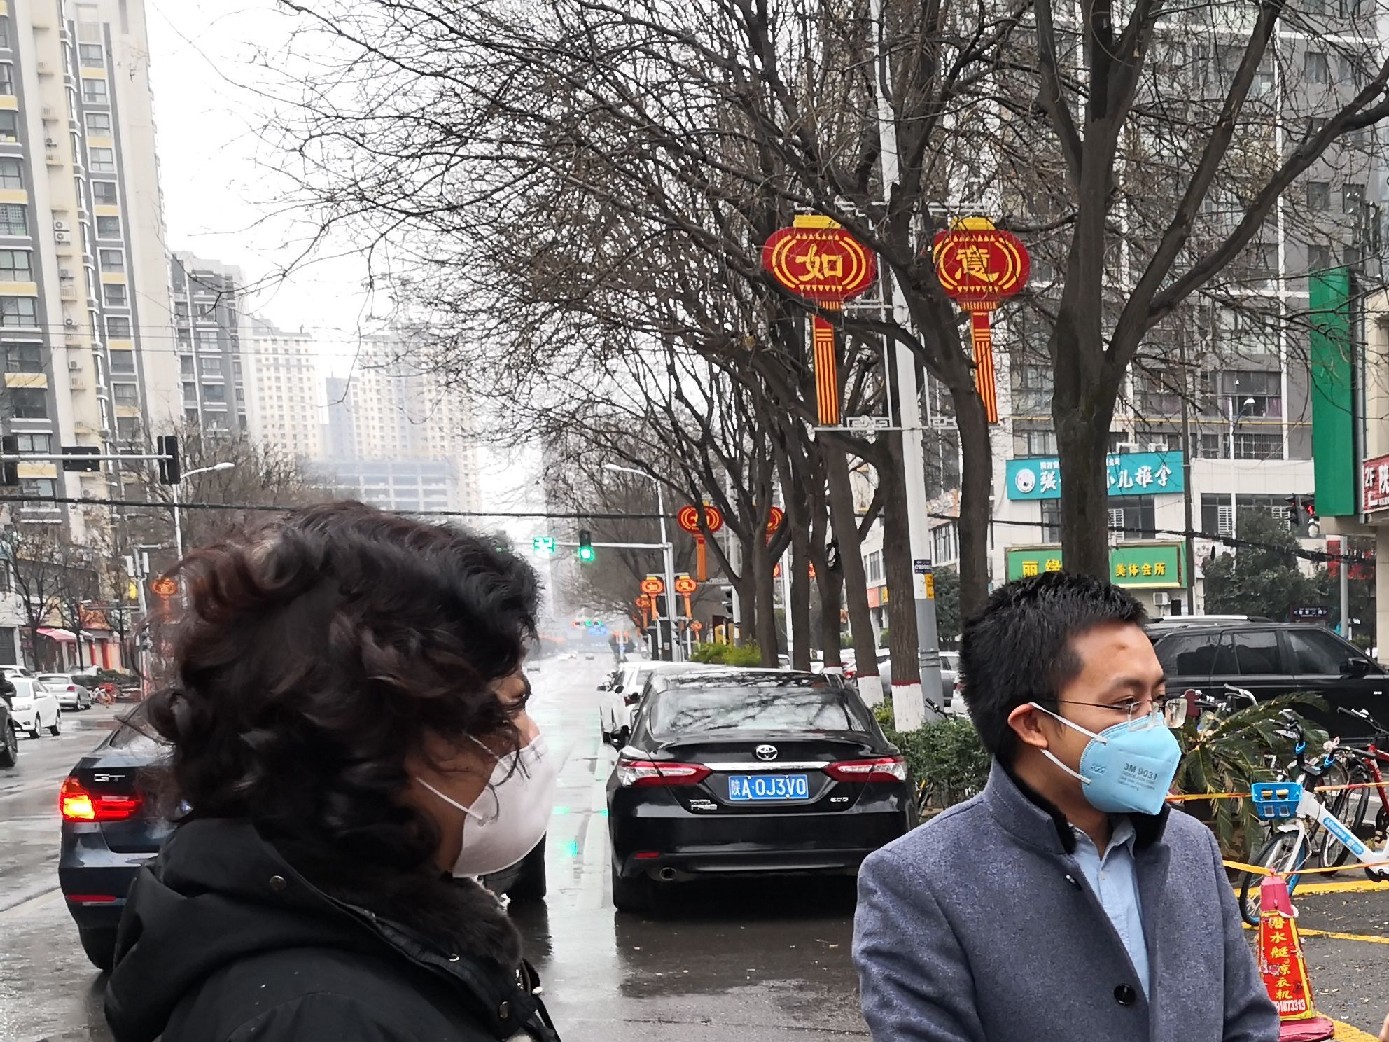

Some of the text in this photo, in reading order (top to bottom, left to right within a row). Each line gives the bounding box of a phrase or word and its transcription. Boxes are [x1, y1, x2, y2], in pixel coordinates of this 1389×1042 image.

[795, 243, 843, 282] 如
[954, 245, 1000, 283] 意
[1115, 562, 1166, 577] 美体会所
